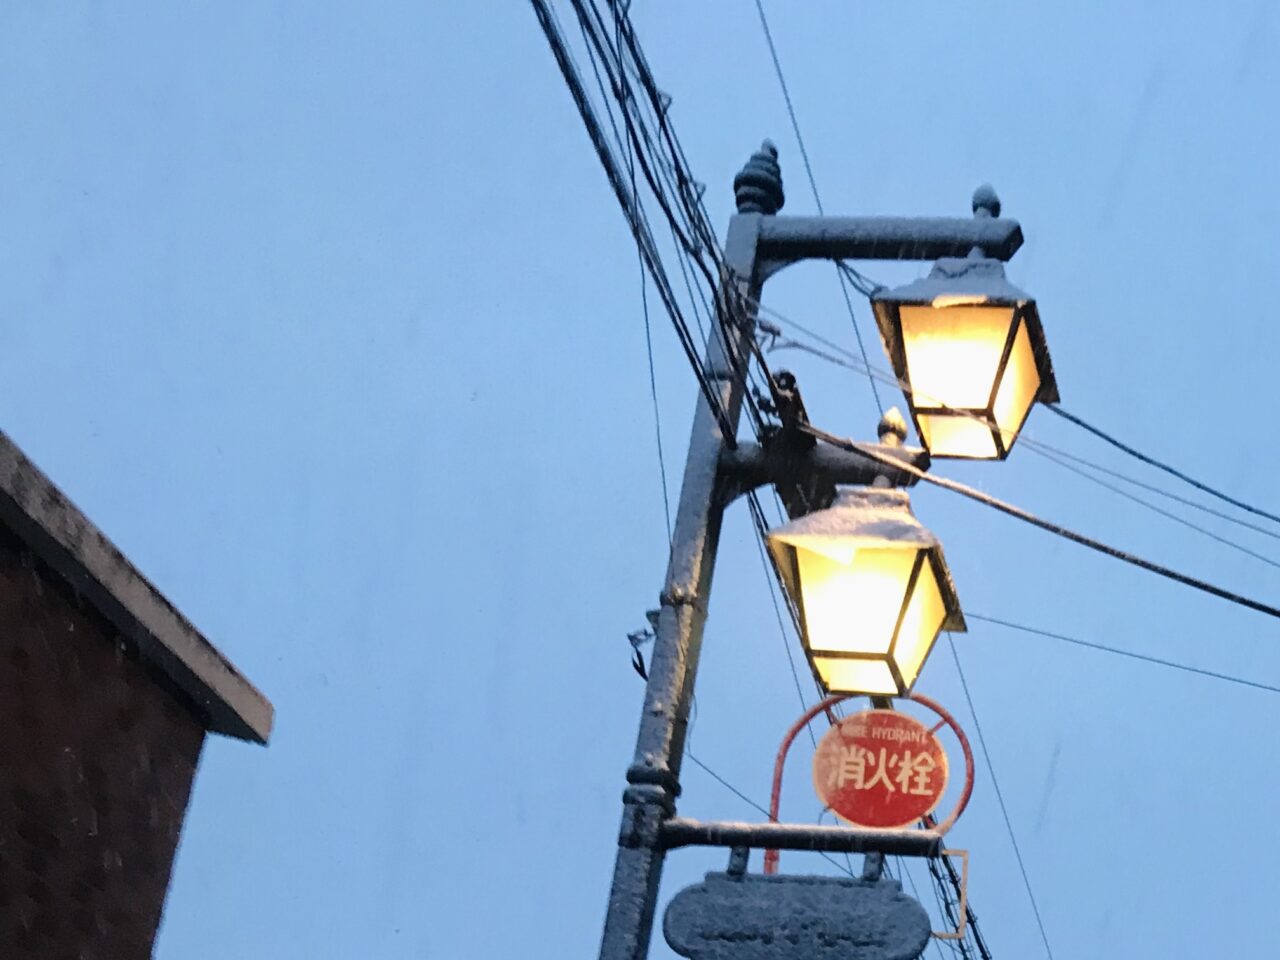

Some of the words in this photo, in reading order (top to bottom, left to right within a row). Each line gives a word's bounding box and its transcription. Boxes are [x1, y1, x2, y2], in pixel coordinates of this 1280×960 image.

[840, 724, 867, 739] RE
[872, 727, 928, 743] HYDRANT
[828, 745, 936, 796] 消火栓
